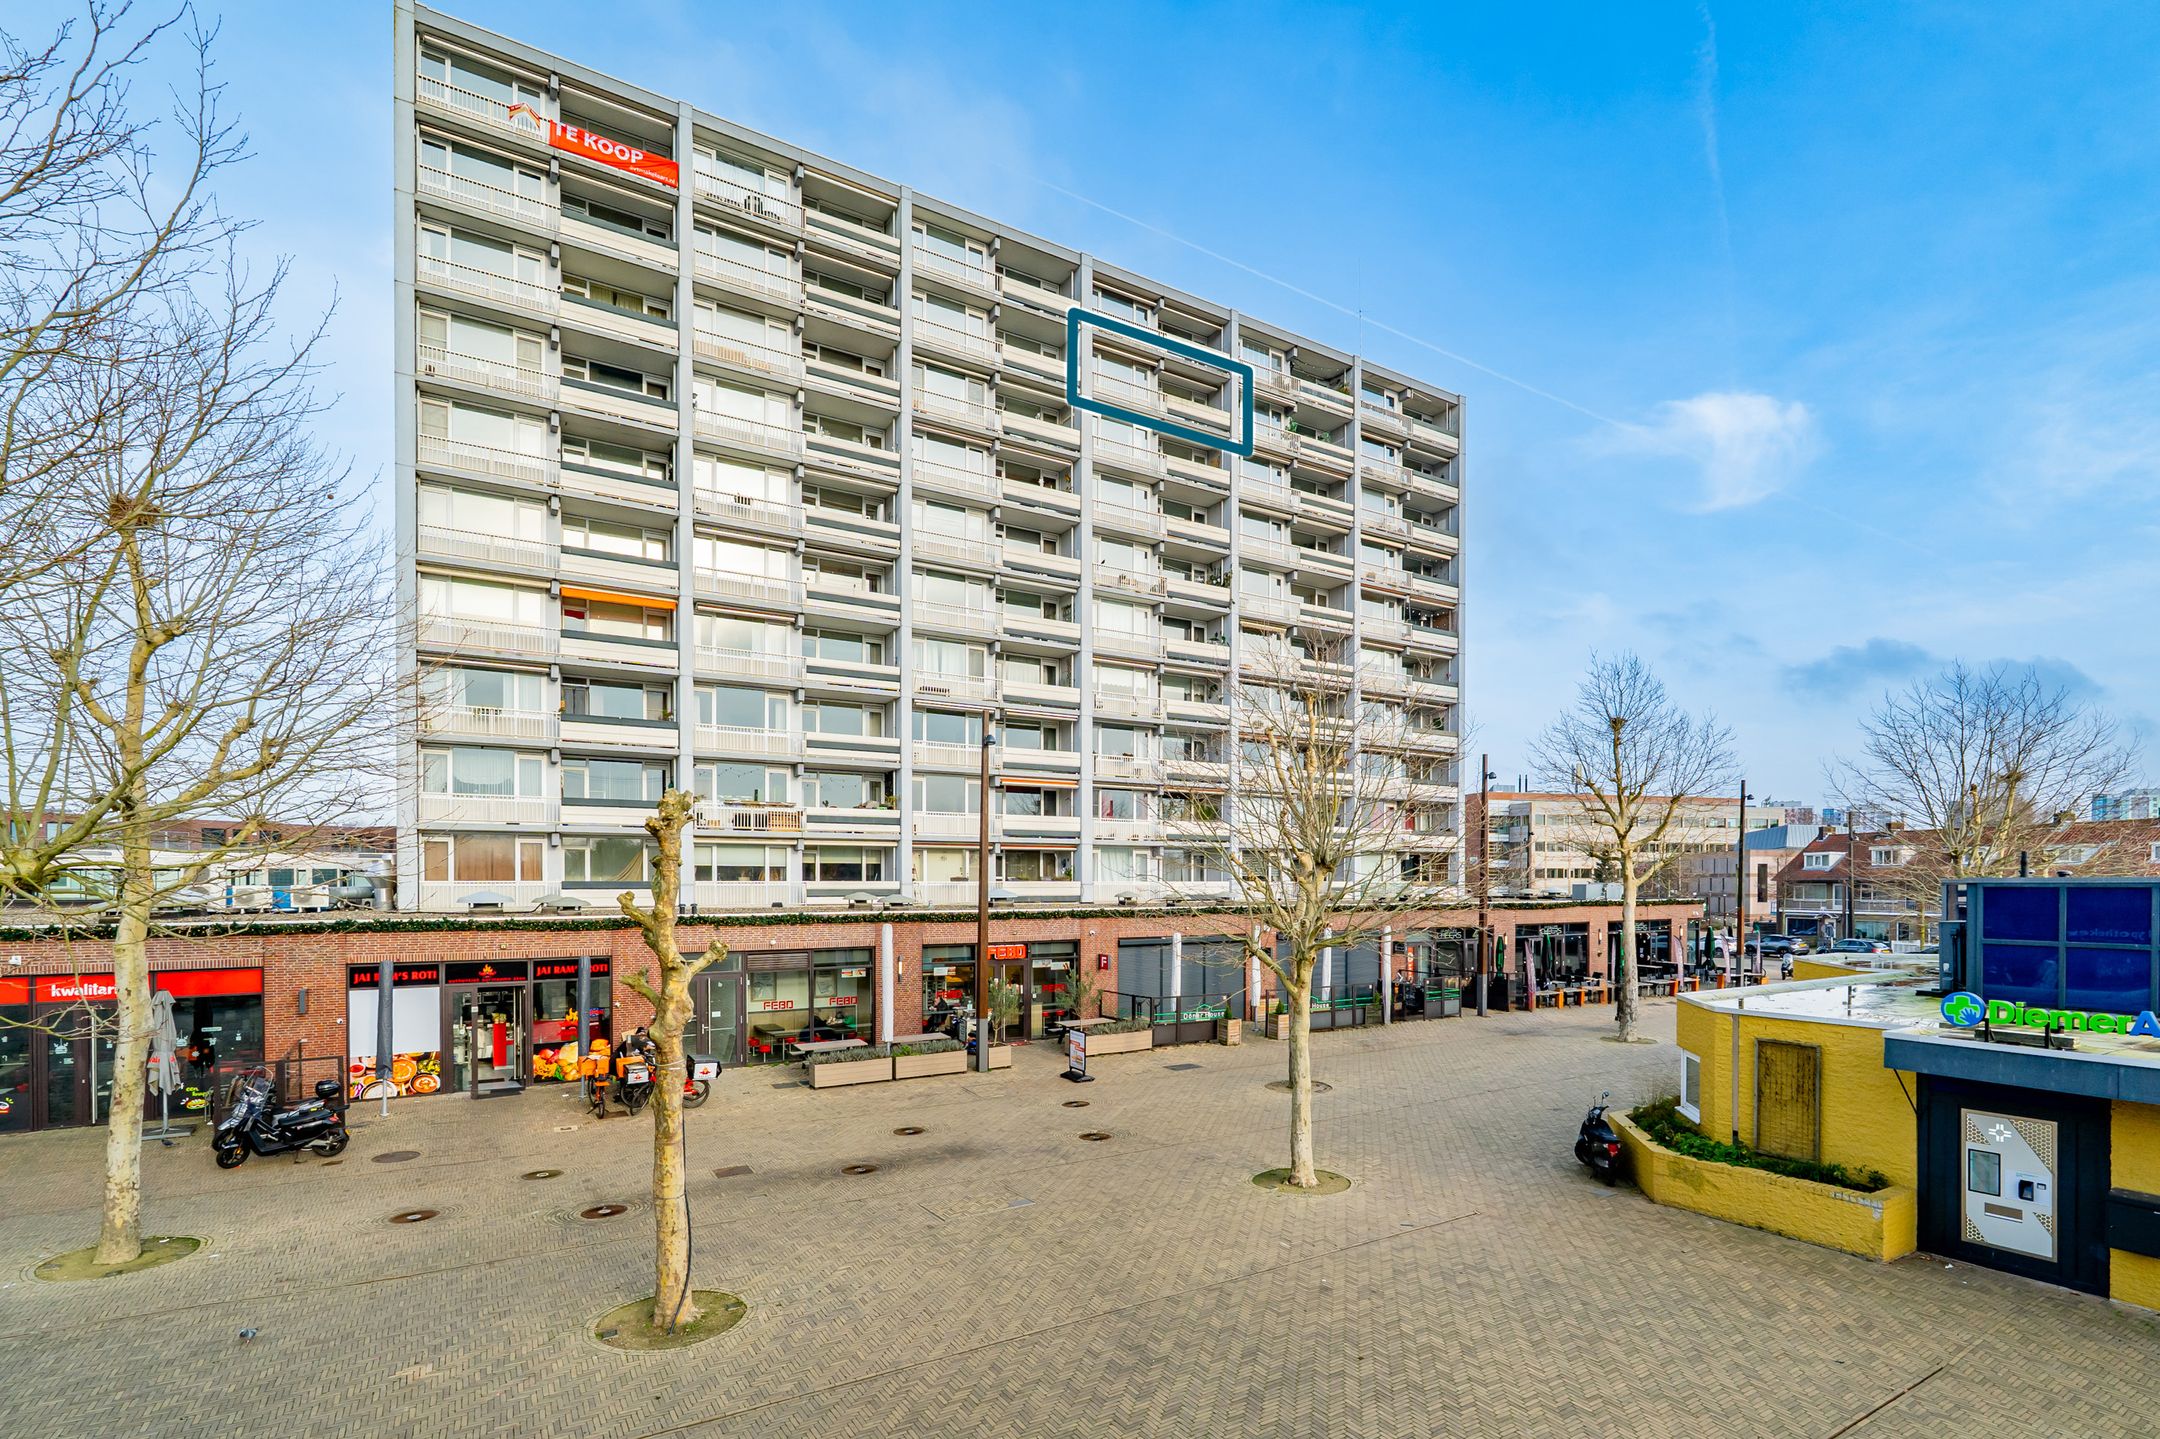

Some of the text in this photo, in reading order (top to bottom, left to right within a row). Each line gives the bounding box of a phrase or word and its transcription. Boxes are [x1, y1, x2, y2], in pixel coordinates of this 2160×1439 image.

[553, 121, 643, 163] TE KOOP
[987, 944, 1027, 960] FEBO
[1101, 955, 1108, 968] F
[353, 973, 371, 985] JAI
[411, 971, 437, 981] ROTI
[536, 966, 551, 977] JAI
[764, 1000, 793, 1010] FEBO
[829, 996, 858, 1006] FEBO
